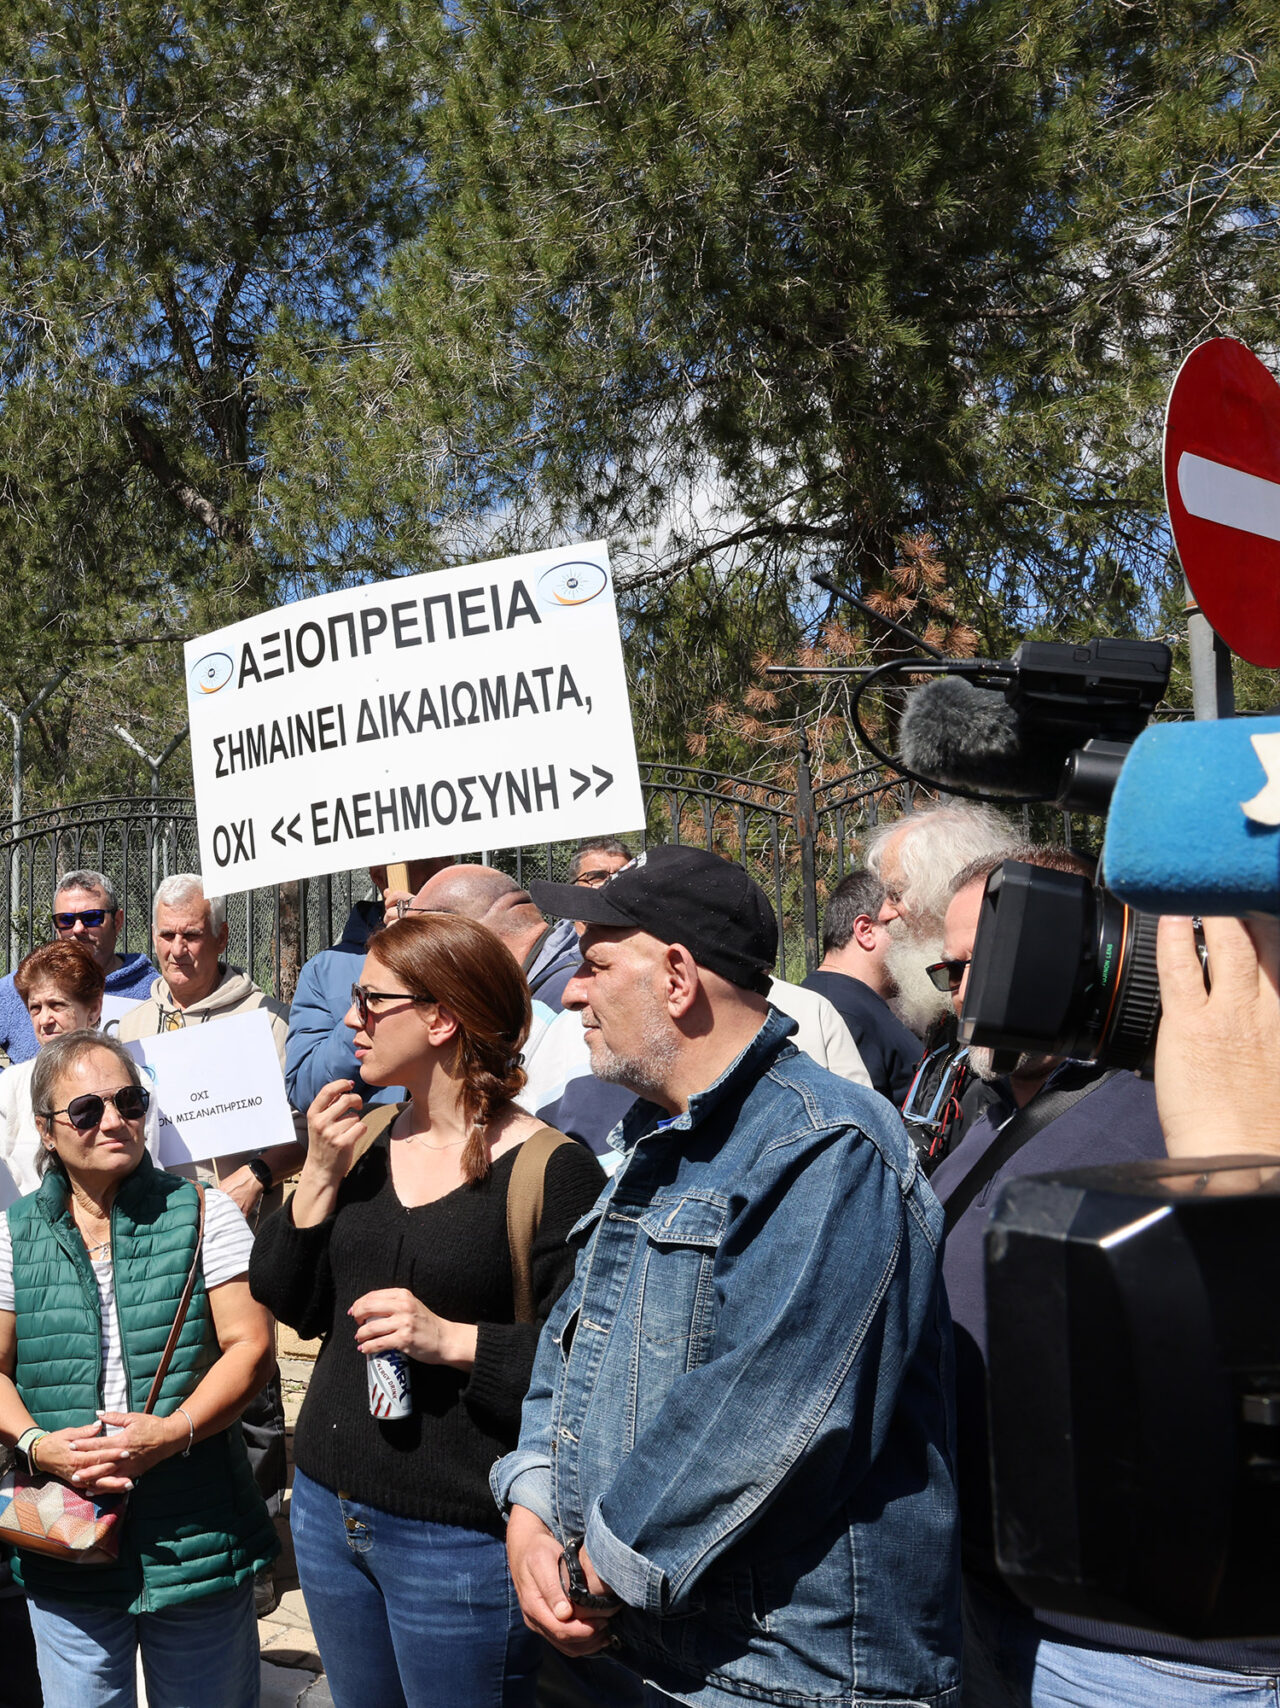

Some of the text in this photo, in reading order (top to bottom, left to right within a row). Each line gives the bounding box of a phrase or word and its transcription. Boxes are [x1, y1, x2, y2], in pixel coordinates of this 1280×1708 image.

[237, 579, 542, 689] ΑΞΙΟΠΡΕΠΕΙΑ
[213, 664, 593, 779] ΣΗΜΑΙΝΕΙ ΔΙΚΑΙΩΜΑΤΑ,
[213, 819, 256, 867] ΟΧΙ
[176, 1096, 263, 1124] ΜΙΣΑΝΑΠΗΡΙΣΜΟ
[190, 1090, 209, 1102] ΟΧΙ
[375, 1349, 410, 1402] HARK
